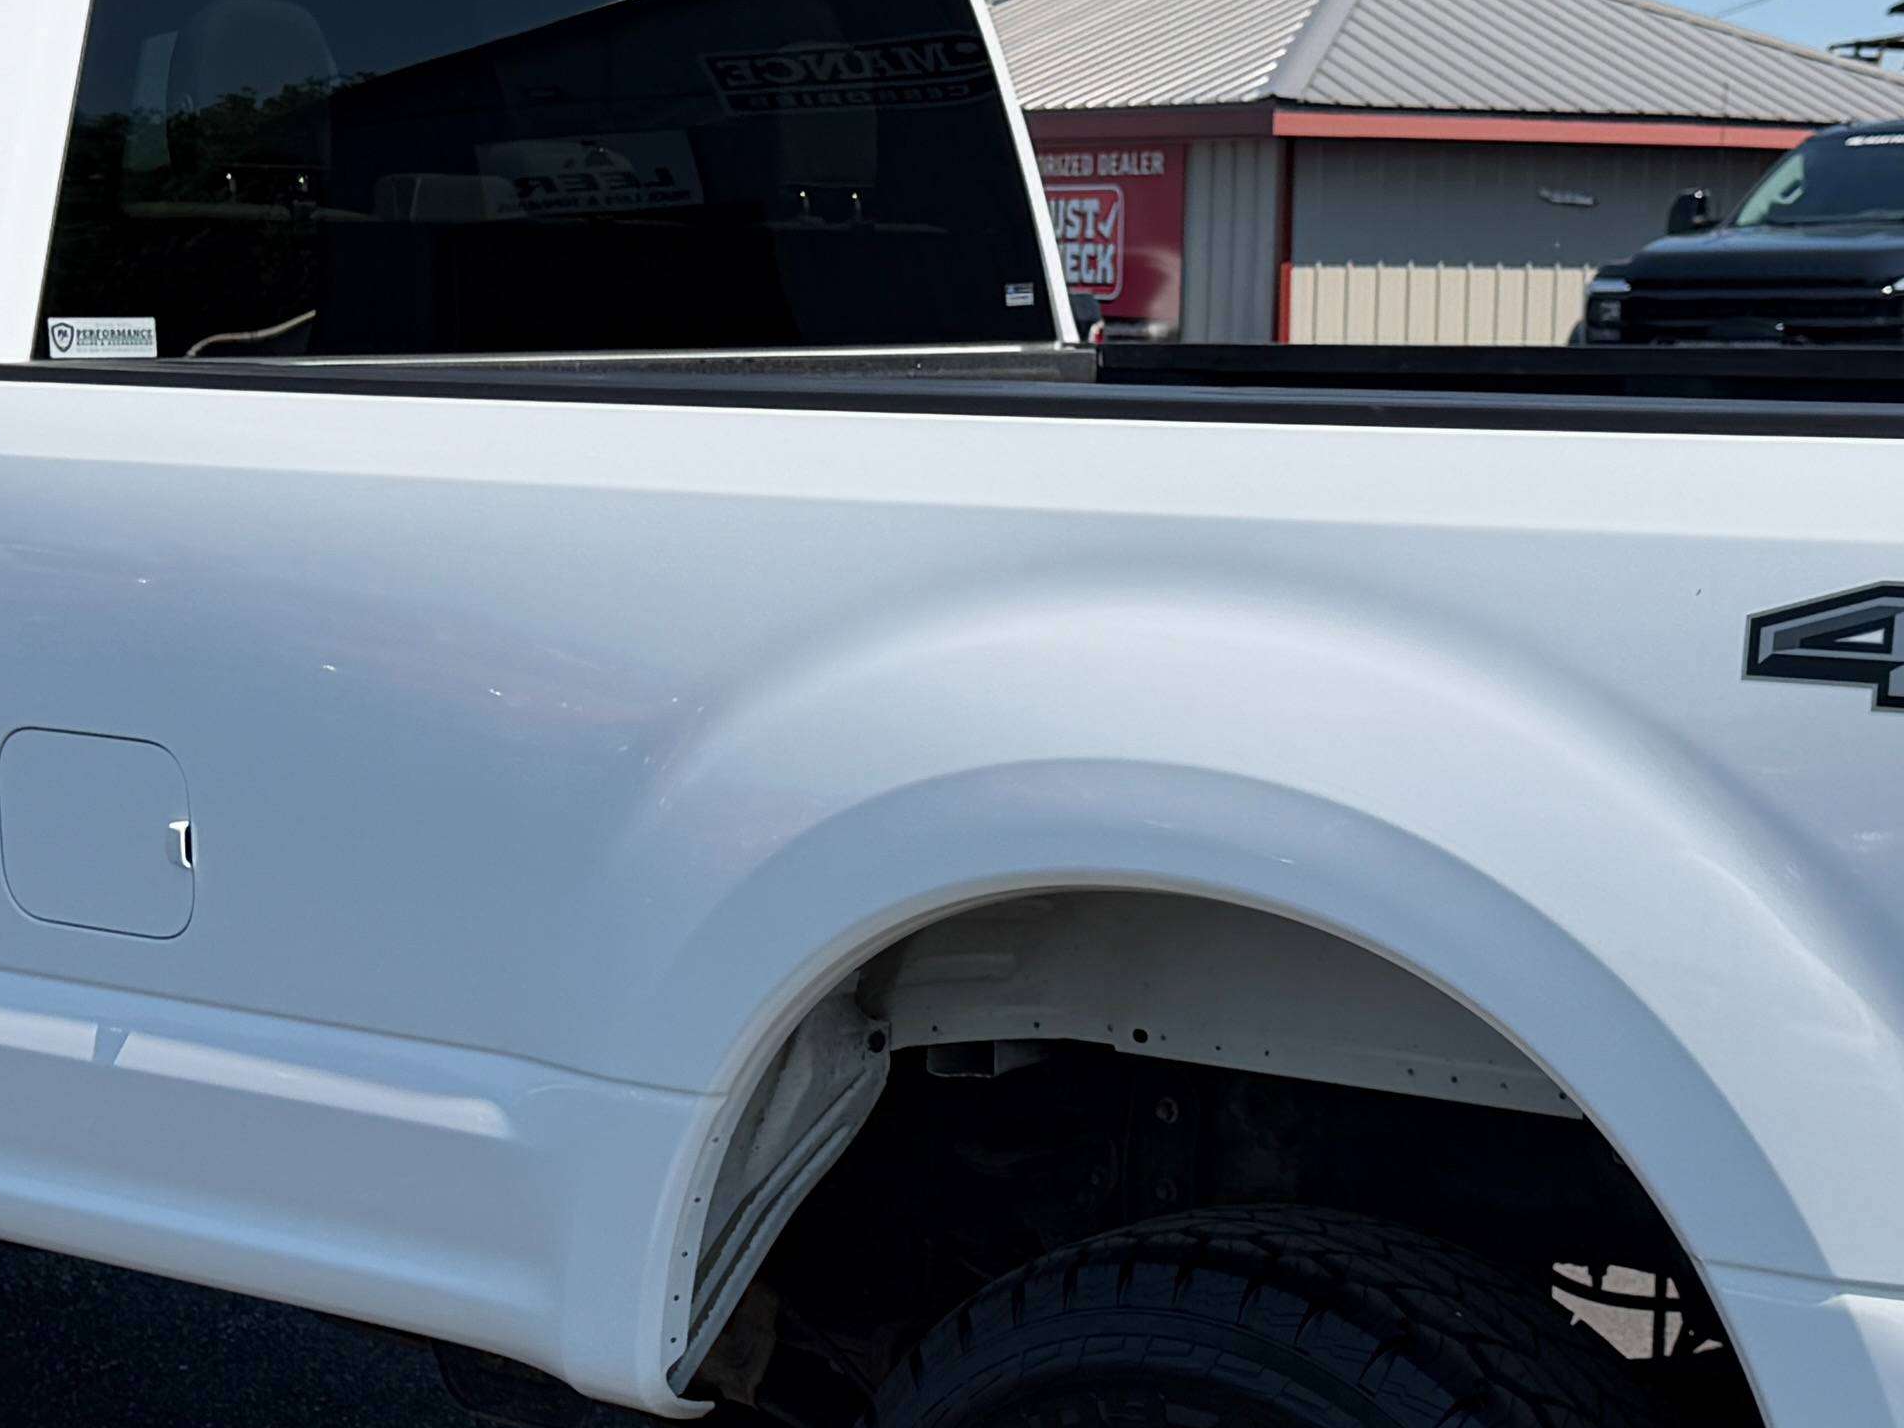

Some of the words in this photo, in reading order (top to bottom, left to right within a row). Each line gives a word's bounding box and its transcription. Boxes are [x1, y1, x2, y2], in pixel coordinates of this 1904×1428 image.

[1038, 153, 1093, 177] RIZED
[1097, 150, 1165, 177] DEALER
[1047, 198, 1101, 240] UST
[76, 328, 153, 340] PERFORMANCE
